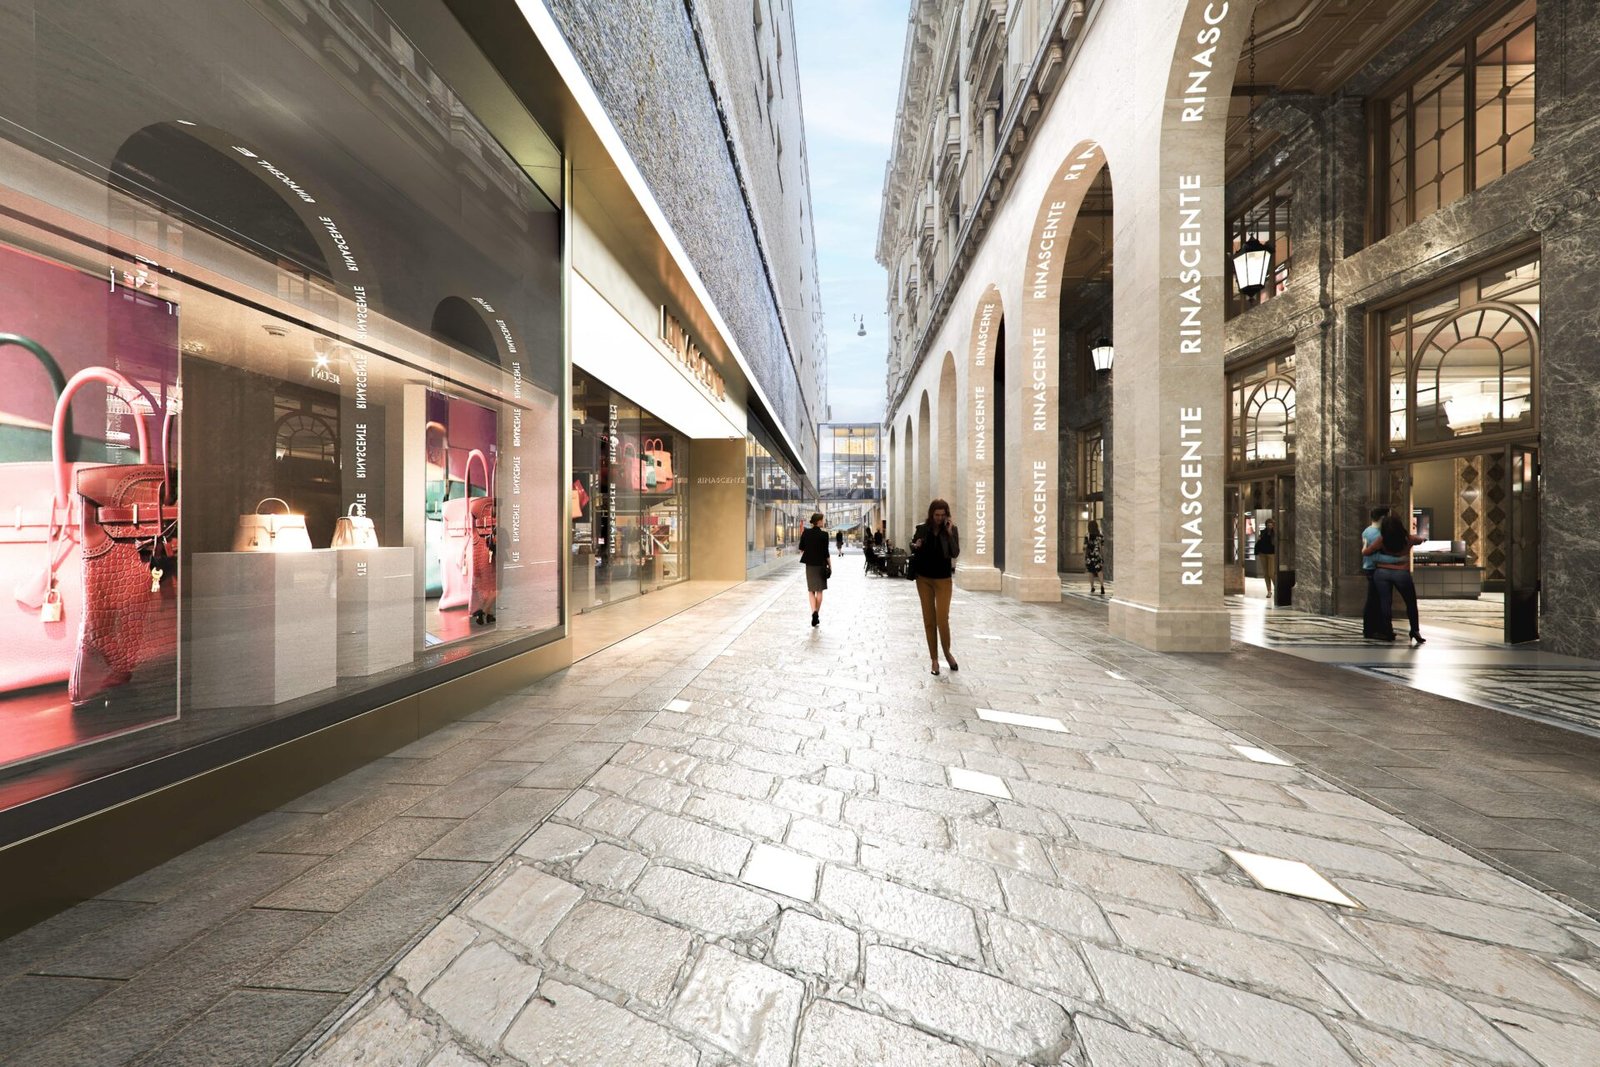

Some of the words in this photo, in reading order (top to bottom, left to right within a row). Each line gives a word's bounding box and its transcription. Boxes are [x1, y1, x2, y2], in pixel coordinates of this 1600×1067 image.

[1033, 201, 1066, 299] RINASCENTE
[1179, 175, 1202, 354] RINASCENTE
[976, 303, 995, 366] RINASCENTE
[1033, 327, 1047, 431] RINASCENTE
[975, 386, 985, 460] RINASCENTE
[975, 481, 986, 555] RINASCENTE
[1033, 461, 1047, 564] RINASCENTE
[1180, 408, 1203, 585] RINASCENTE
